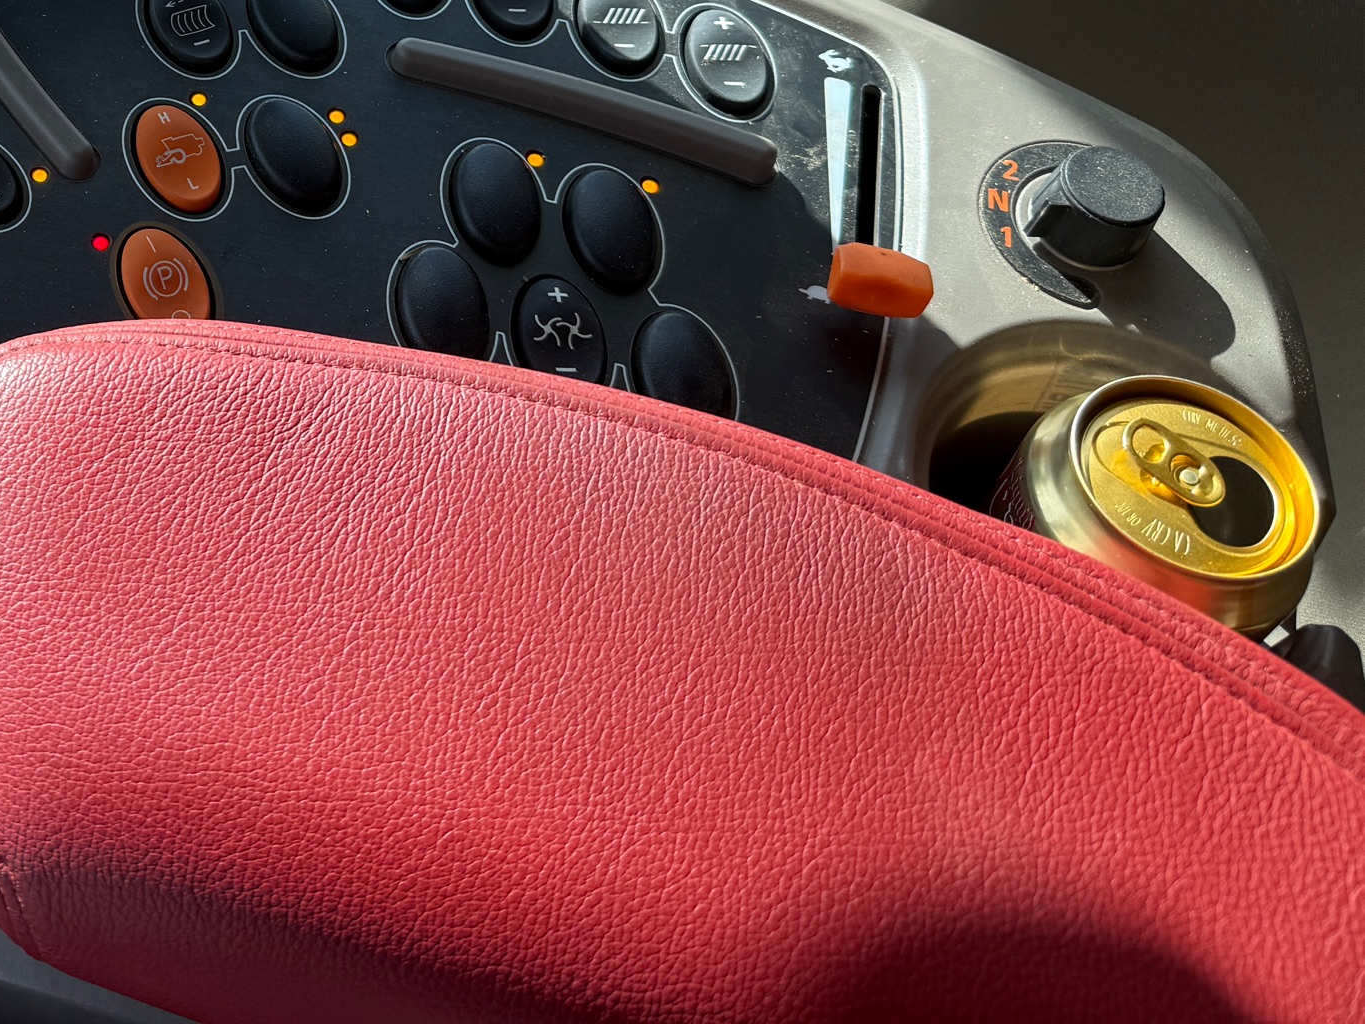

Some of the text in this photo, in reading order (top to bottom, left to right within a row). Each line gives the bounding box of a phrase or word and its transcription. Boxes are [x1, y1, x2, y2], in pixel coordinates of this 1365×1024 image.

[157, 111, 171, 125] H
[1002, 159, 1020, 182] 2
[186, 177, 200, 190] L
[987, 187, 1010, 213] N
[1000, 226, 1012, 248] 1
[157, 265, 173, 290] P
